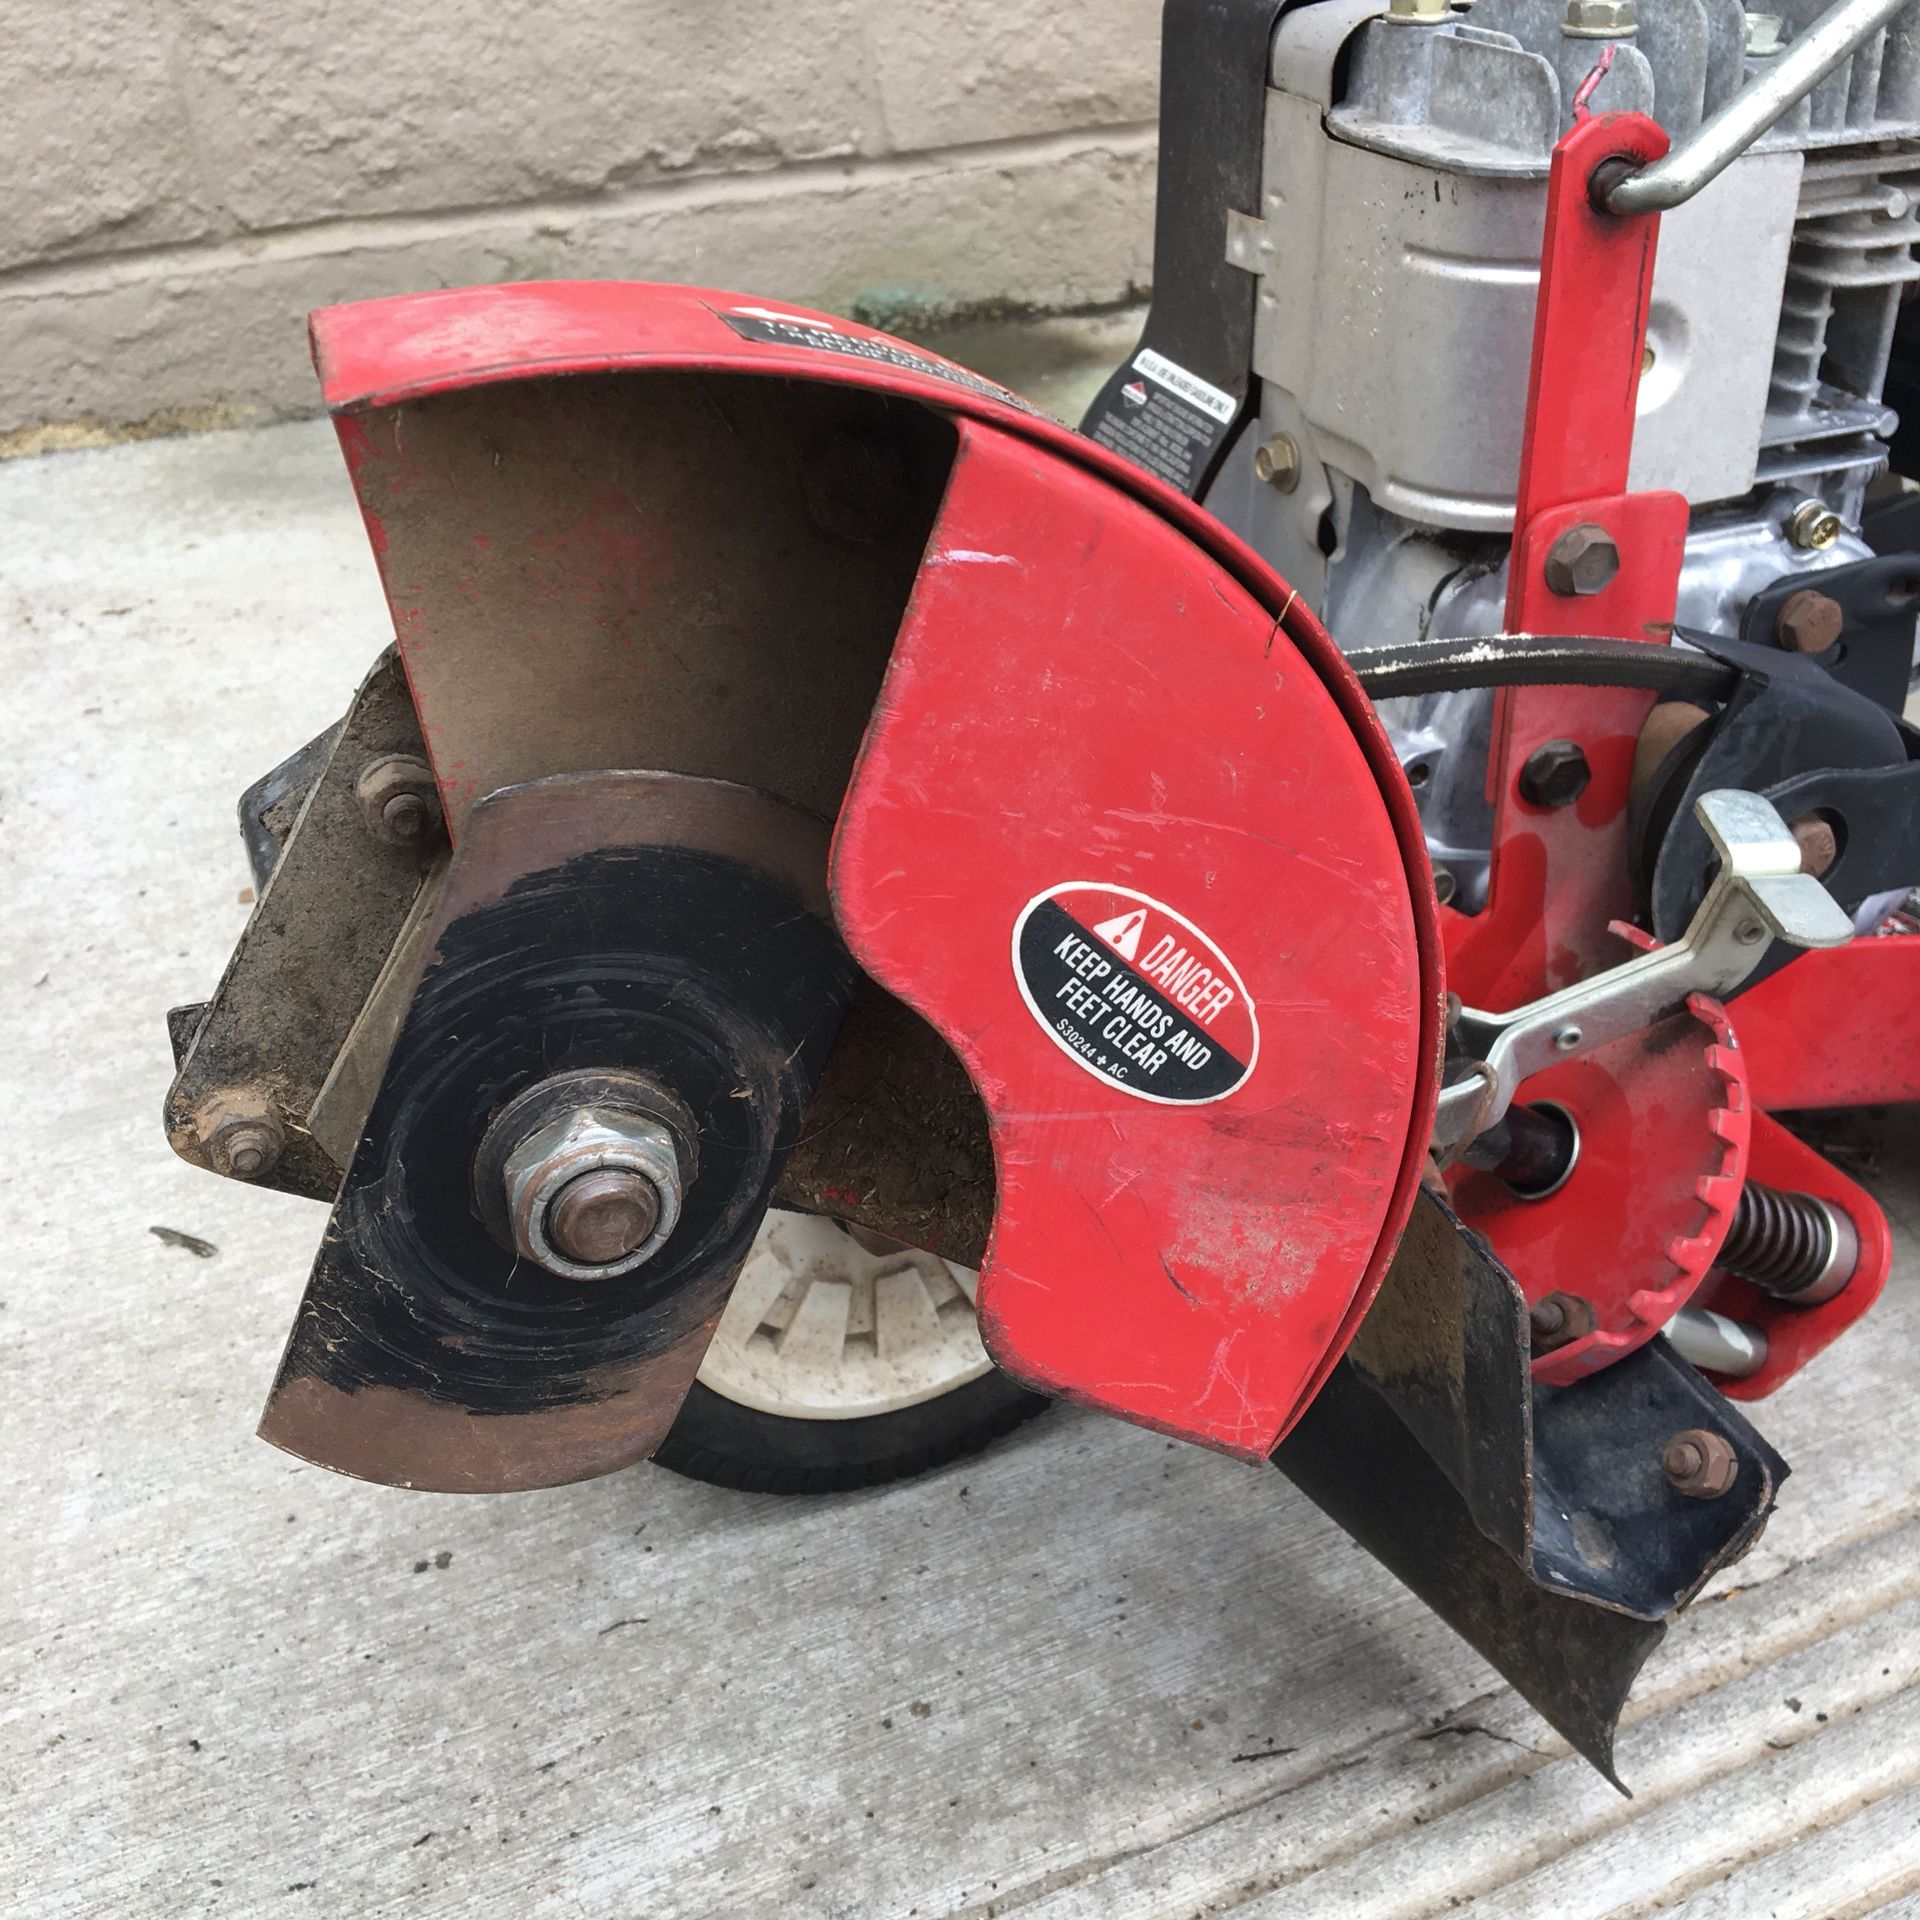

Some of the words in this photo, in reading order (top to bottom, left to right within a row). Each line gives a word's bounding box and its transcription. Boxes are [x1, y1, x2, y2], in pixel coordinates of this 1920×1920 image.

[1053, 932, 1111, 982] KEEP
[1102, 974, 1174, 1038] HANDS
[1164, 1029, 1212, 1071] AND
[1055, 977, 1112, 1026] FEET
[1102, 1016, 1168, 1075] CLEAR
[1139, 934, 1235, 1025] DANGER
[1056, 1018, 1096, 1059] S30244
[1107, 1062, 1128, 1079] AC
